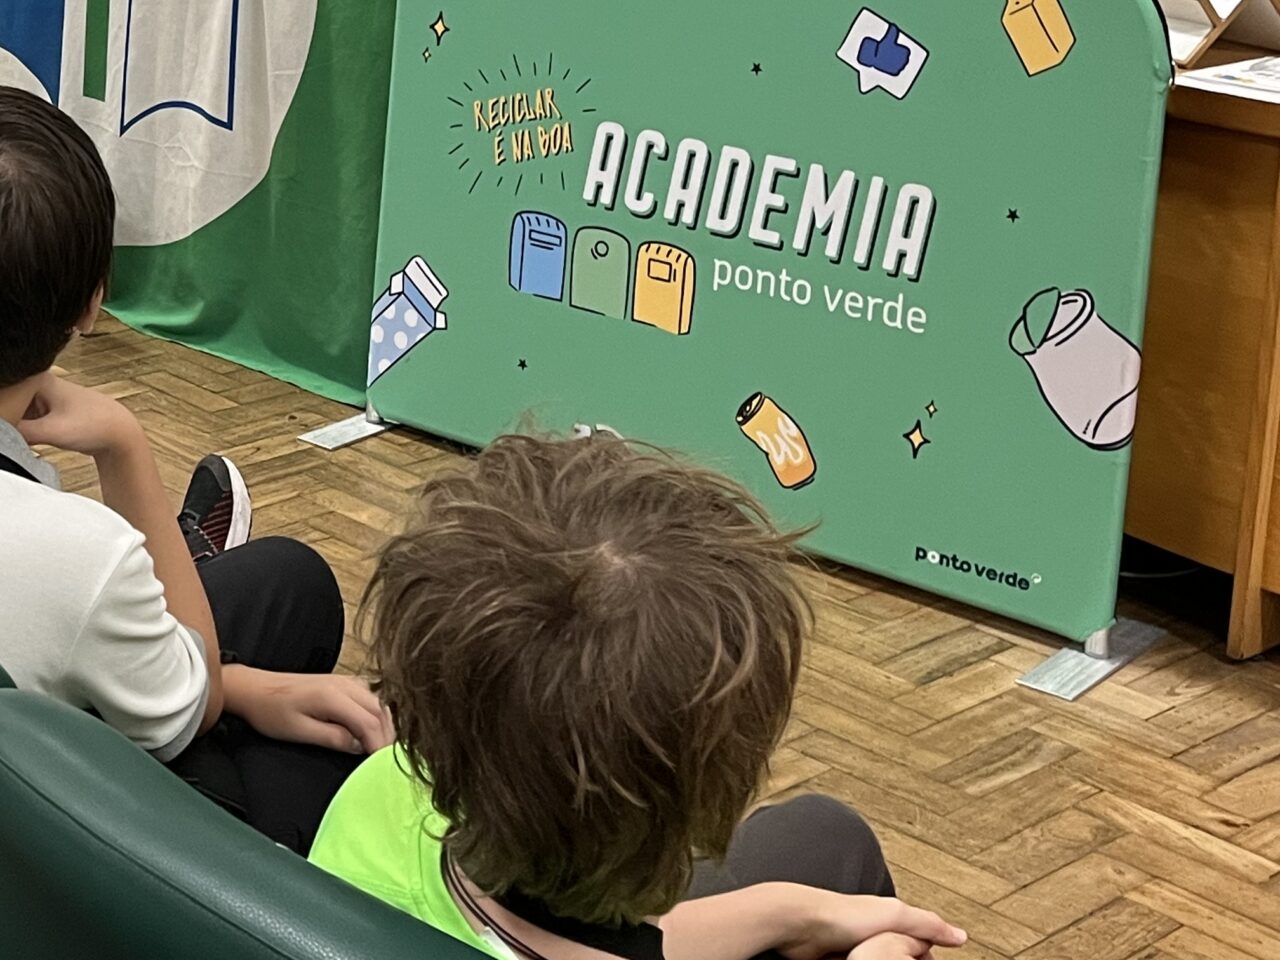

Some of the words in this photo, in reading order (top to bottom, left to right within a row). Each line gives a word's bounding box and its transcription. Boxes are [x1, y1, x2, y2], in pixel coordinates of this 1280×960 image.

[473, 87, 563, 133] RECICLAR
[494, 129, 507, 166] É
[512, 129, 535, 163] NA
[537, 121, 574, 158] BOA
[582, 120, 937, 283] ACADEMIA
[712, 258, 812, 305] ponto
[823, 284, 927, 334] verde
